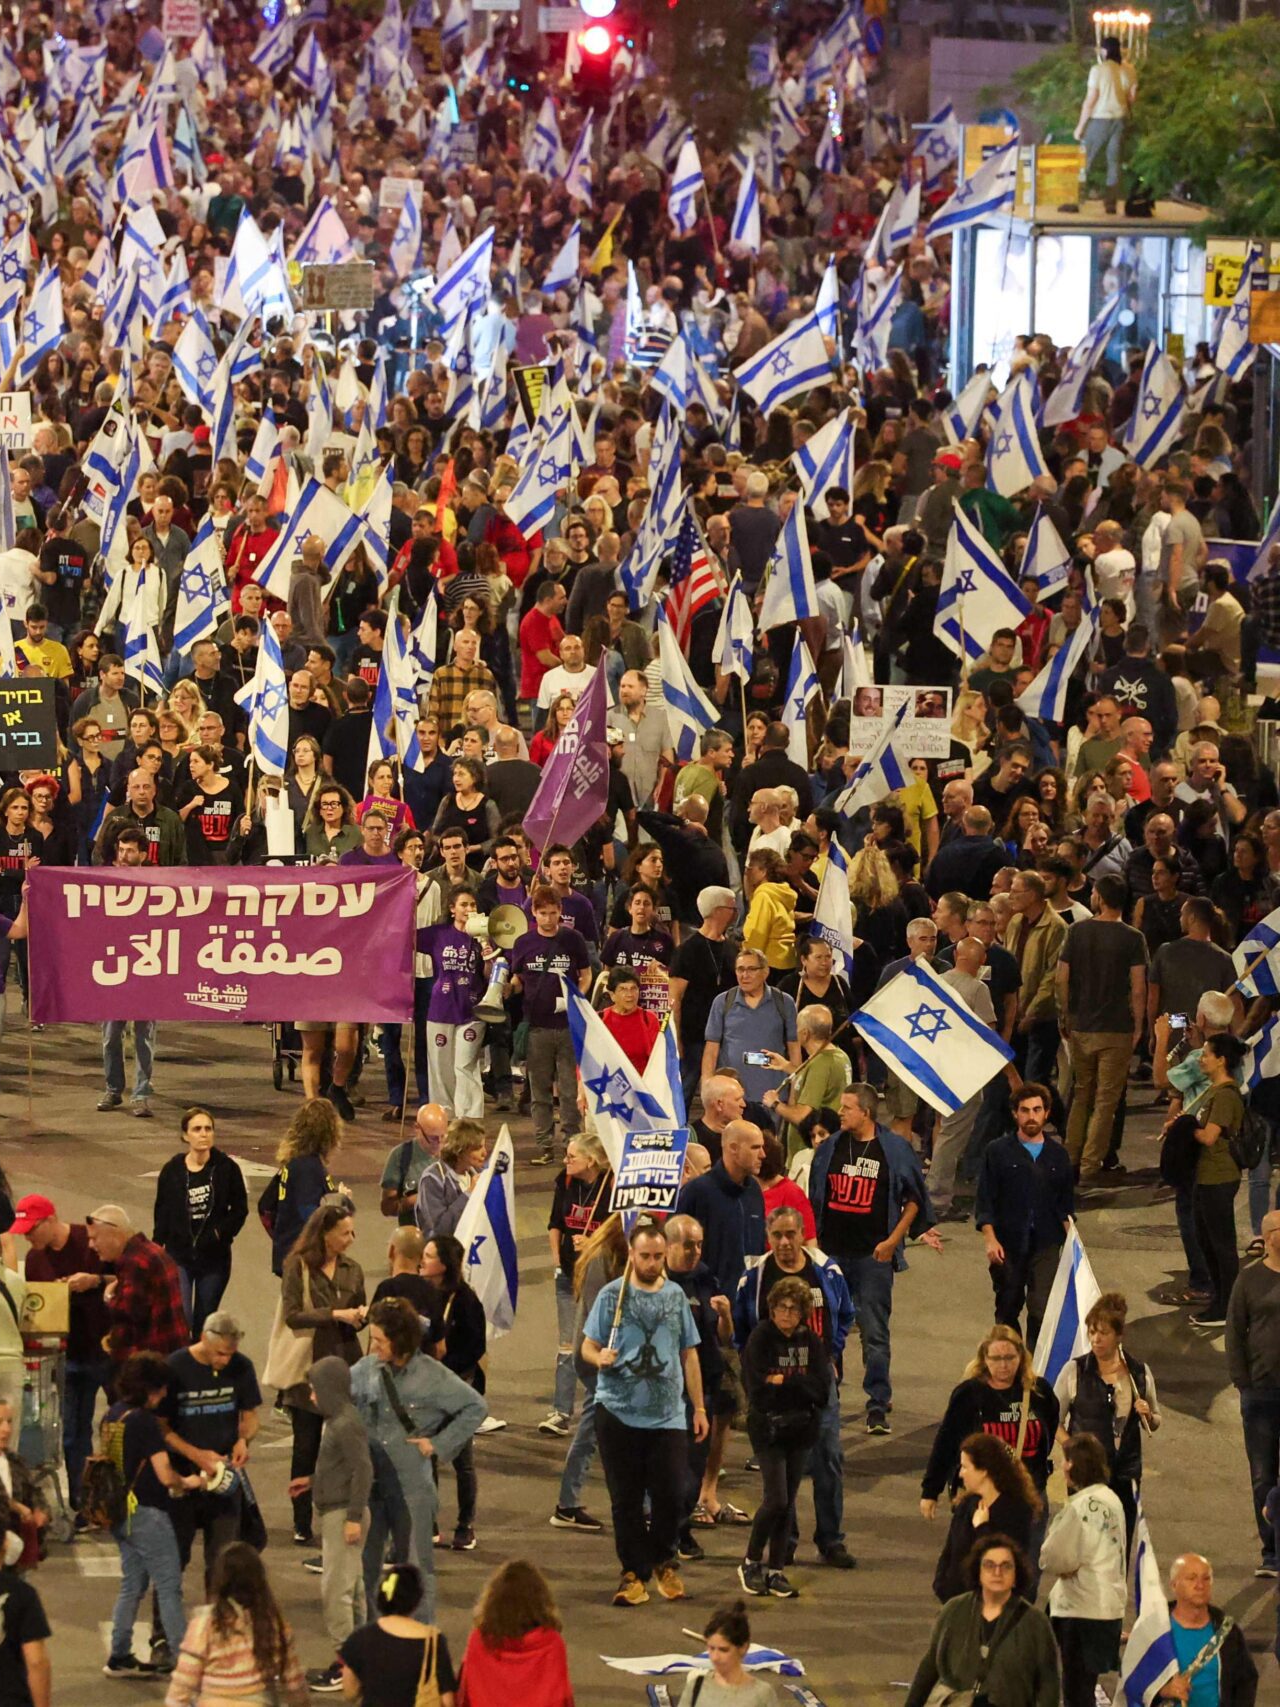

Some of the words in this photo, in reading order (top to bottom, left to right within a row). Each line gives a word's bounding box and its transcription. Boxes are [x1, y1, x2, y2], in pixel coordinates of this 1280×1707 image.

[2, 709, 23, 727] או
[11, 732, 42, 746] בכי
[63, 883, 213, 918] עכשיו
[226, 882, 376, 927] עסקה
[92, 928, 180, 986] الآن
[197, 925, 342, 976] صفقة
[184, 993, 209, 1002] ביחד
[210, 993, 248, 1003] עומדים
[617, 1169, 679, 1186] בחירות
[616, 1187, 676, 1208] עכשיו!
